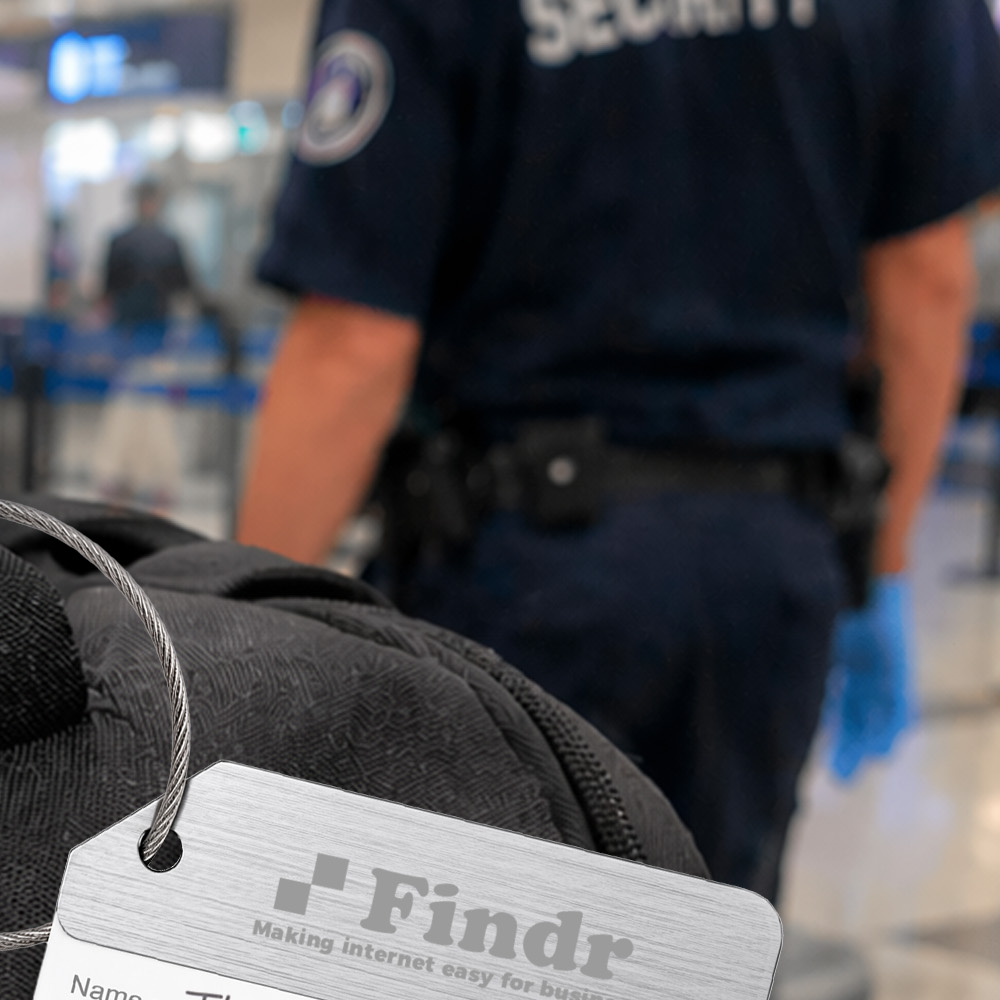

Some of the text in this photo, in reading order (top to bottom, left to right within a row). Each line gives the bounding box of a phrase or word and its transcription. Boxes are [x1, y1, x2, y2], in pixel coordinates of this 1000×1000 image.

[252, 919, 335, 954] Making
[342, 936, 435, 973] internet
[442, 963, 494, 988] easy
[501, 972, 534, 994] for
[360, 867, 634, 980] Findr
